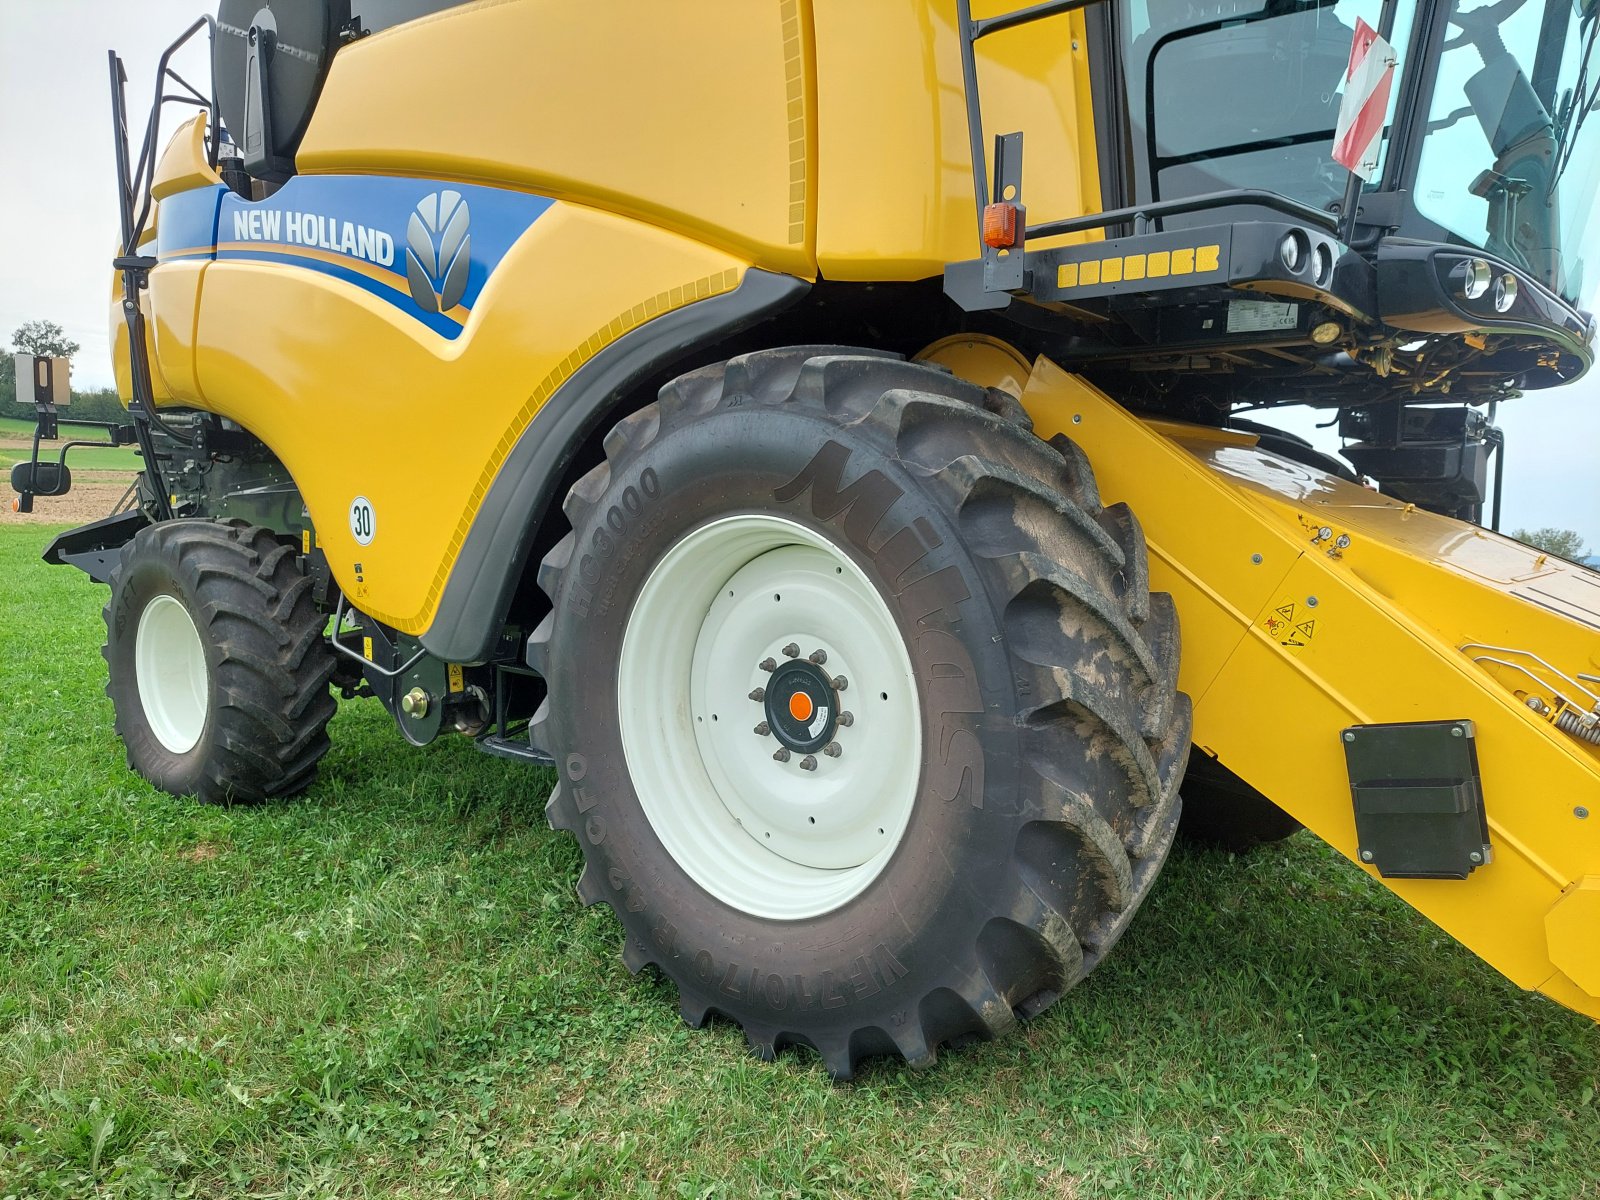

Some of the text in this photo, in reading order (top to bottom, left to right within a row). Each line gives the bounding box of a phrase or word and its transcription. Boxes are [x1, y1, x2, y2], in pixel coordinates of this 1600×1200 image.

[233, 210, 395, 267] NEW HOLLAND
[353, 505, 371, 537] 30
